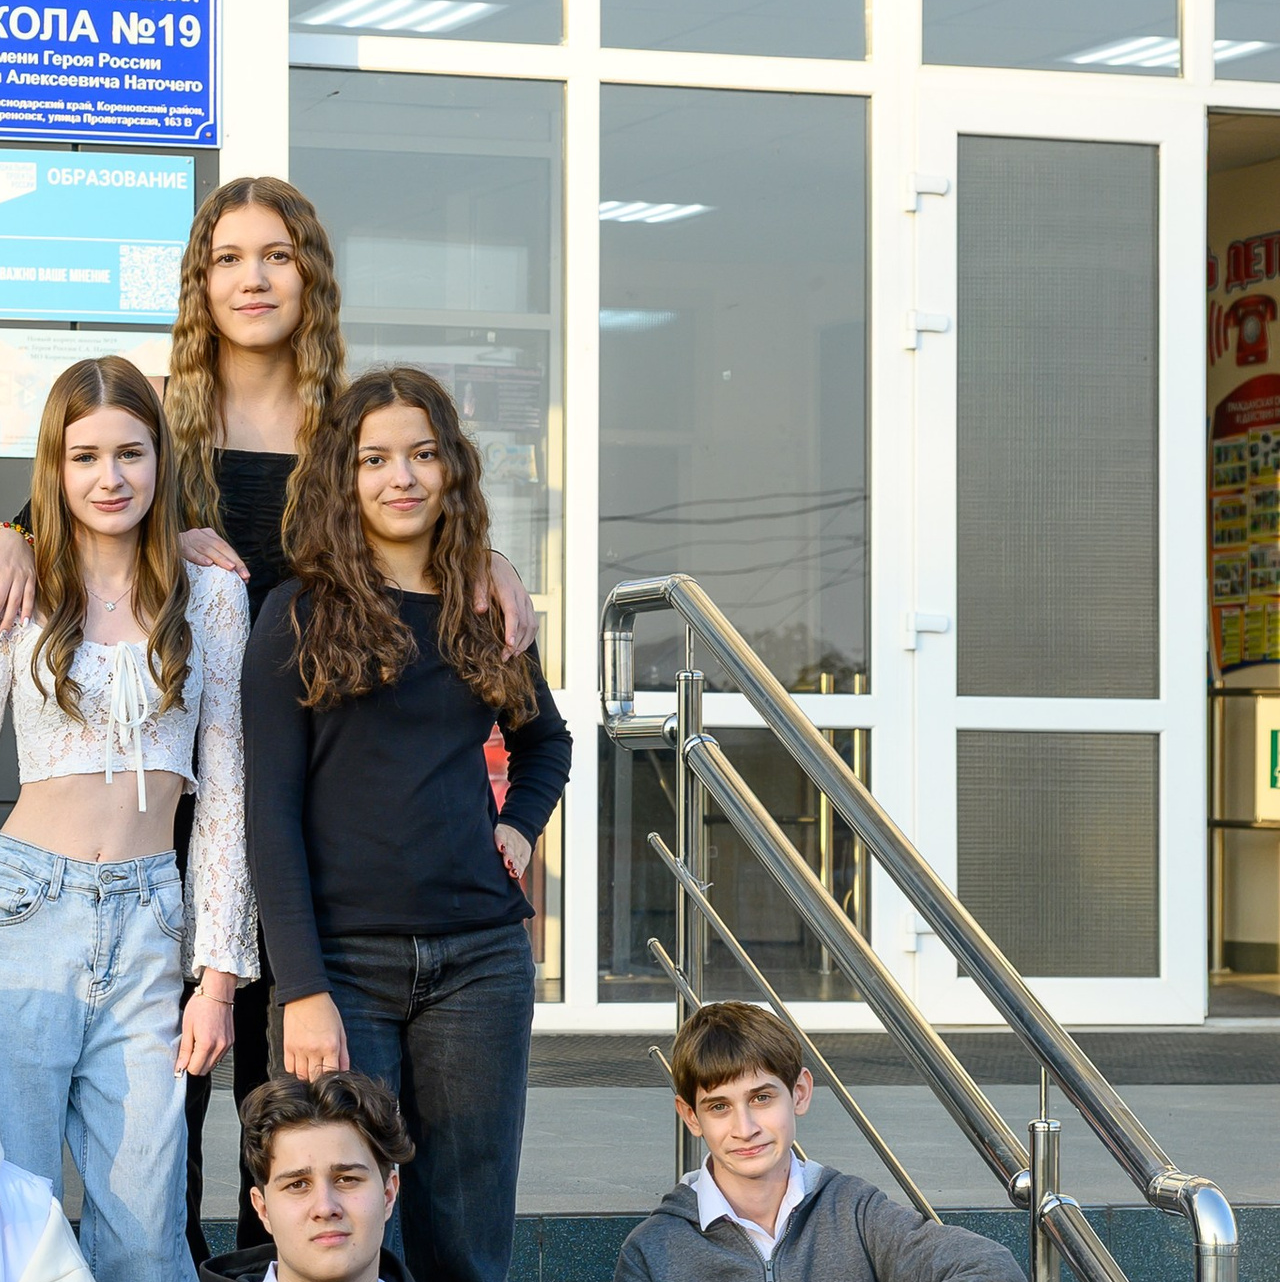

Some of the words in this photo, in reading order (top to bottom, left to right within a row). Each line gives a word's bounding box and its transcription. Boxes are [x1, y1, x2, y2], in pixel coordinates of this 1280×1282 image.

[111, 11, 202, 48] №19
[42, 50, 93, 70] Героя
[97, 52, 162, 71] России
[6, 69, 121, 89] Алексеевича
[123, 74, 204, 93] Наточего
[66, 100, 95, 112] край,
[96, 101, 167, 114] Кореновский
[168, 105, 205, 117] район,
[47, 113, 81, 124] улица
[82, 113, 161, 127] Пролетарская,
[163, 116, 182, 127] 163
[46, 168, 188, 189] ОБРАЗОВАНИЕ
[0, 267, 37, 281] ВАЖНО
[38, 268, 68, 282] ВАШЕ
[69, 268, 111, 283] МНЕНИЕ
